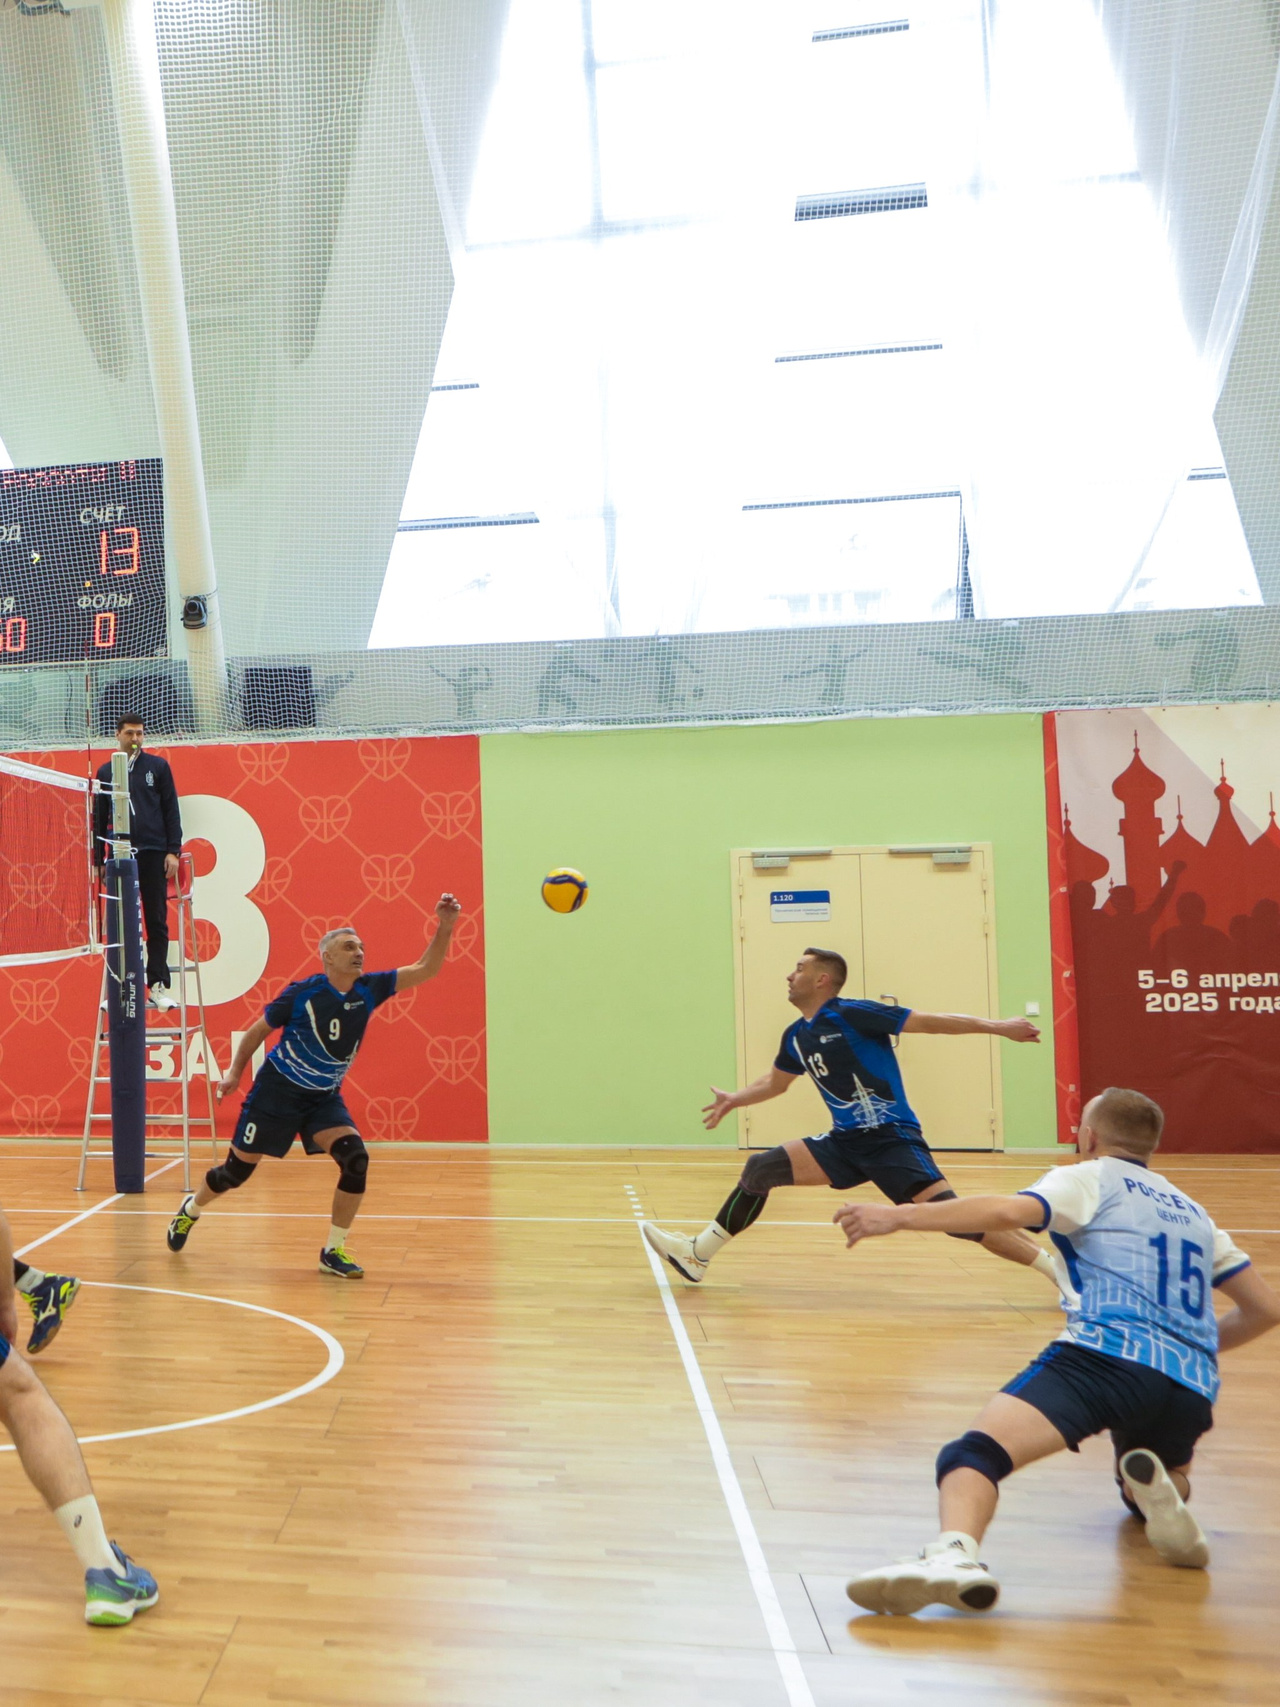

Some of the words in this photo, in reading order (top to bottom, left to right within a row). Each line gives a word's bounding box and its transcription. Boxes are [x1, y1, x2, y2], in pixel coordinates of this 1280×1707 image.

[80, 503, 126, 524] СЧЁТ
[100, 527, 140, 575] 13
[77, 594, 133, 610] ФОЛЫ
[95, 613, 115, 647] 0
[144, 794, 270, 1007] 3
[773, 894, 794, 902] 1.120
[1199, 972, 1280, 993] апрел
[1145, 992, 1219, 1013] 2025
[329, 1018, 340, 1041] 9
[808, 1052, 829, 1078] 13
[243, 1122, 257, 1145] 9
[1156, 1206, 1191, 1226] ЦЕНТР
[1149, 1231, 1205, 1320] 15
